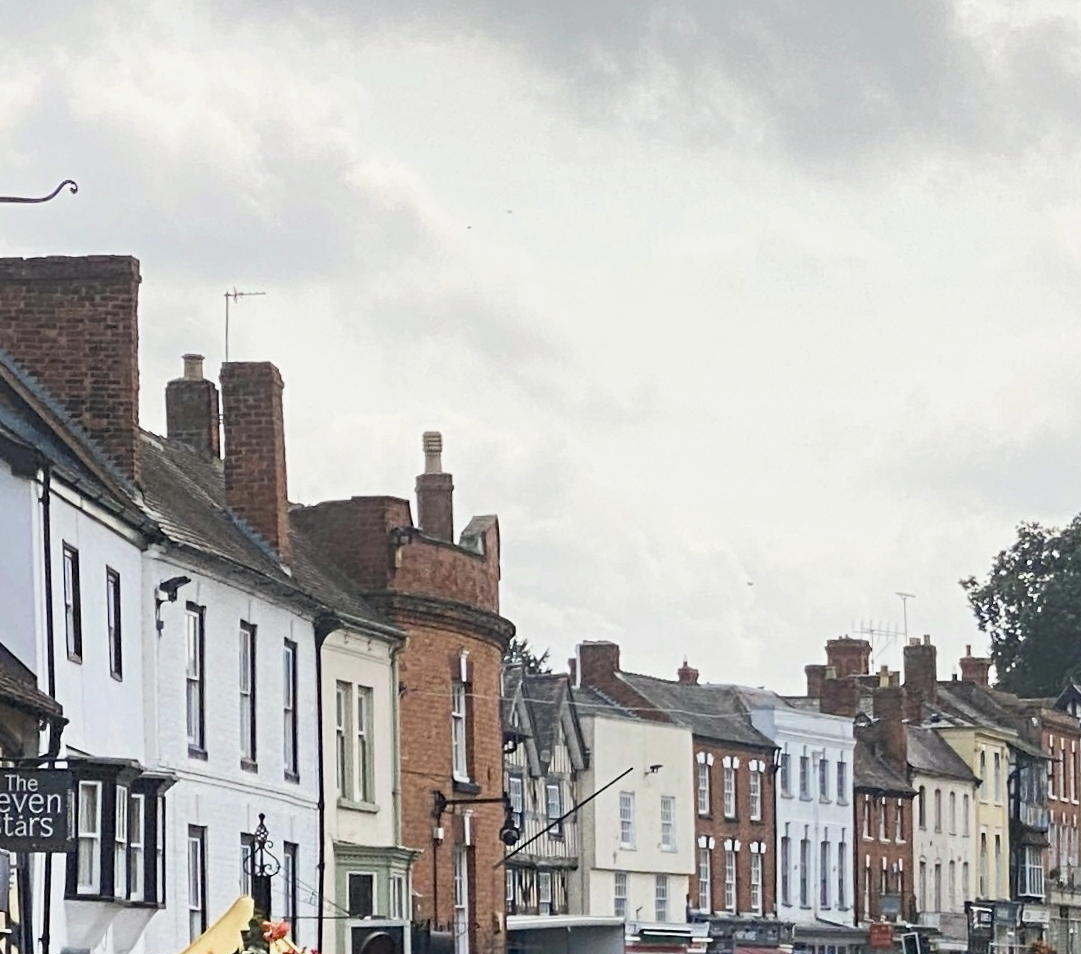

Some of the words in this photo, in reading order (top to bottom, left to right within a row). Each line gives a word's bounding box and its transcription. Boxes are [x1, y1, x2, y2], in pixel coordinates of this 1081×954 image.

[4, 773, 39, 792] The
[0, 792, 61, 813] even
[0, 813, 54, 837] tars
